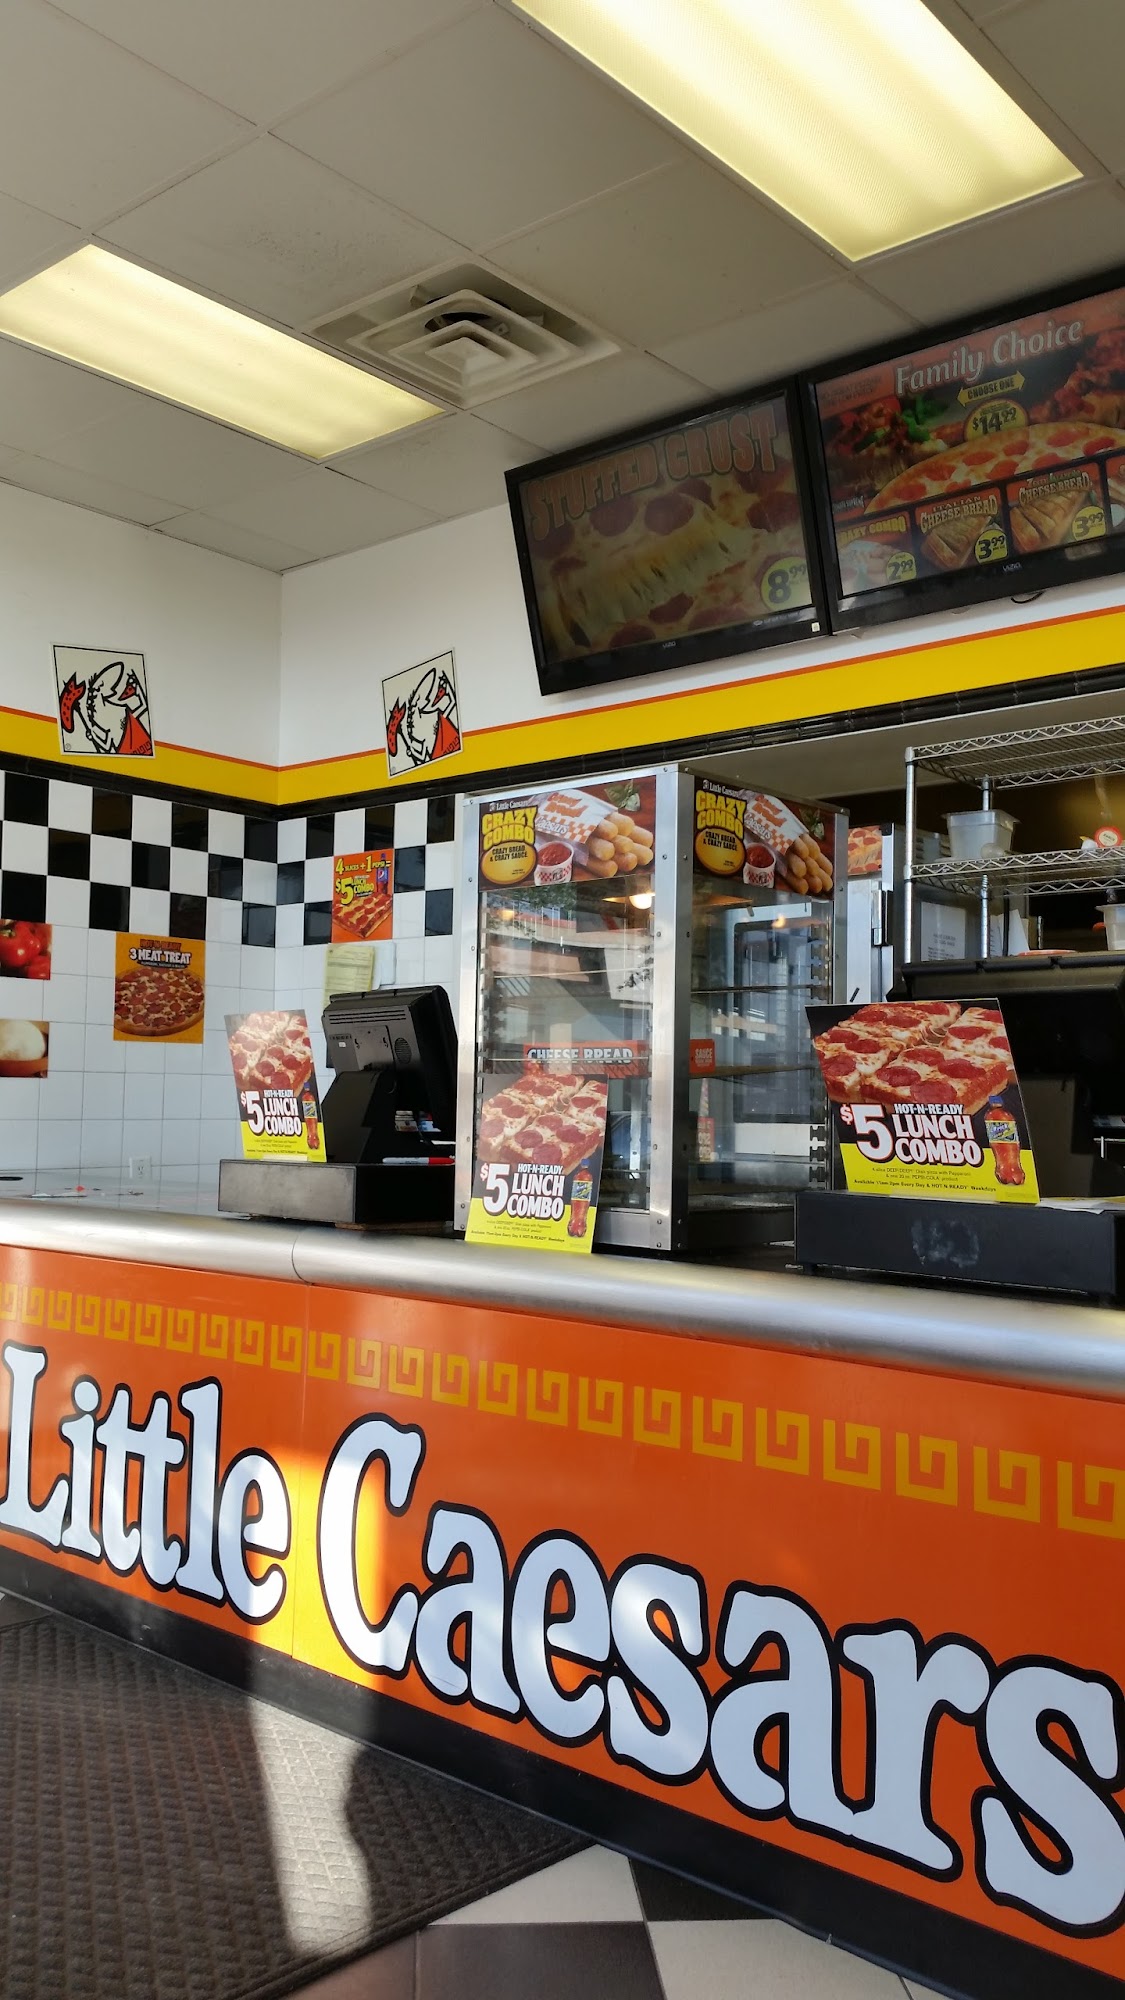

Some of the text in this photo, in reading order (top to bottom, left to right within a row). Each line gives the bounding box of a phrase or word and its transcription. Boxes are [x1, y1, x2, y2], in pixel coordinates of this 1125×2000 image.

[895, 346, 984, 397] Family
[992, 320, 1084, 365] Choice
[967, 377, 1015, 399] CHOOSE ONE
[527, 406, 779, 541] STUFFED CRUST
[932, 496, 981, 512] ITALIAN
[1019, 482, 1057, 507] CHEESE
[868, 515, 907, 534] COMBO
[920, 494, 998, 534] CHEESE BREAD
[695, 789, 747, 823] CRAZY
[481, 806, 538, 836] CRAZY
[534, 816, 570, 836] Caesars
[696, 809, 744, 841] COMBO
[483, 823, 536, 851] COMBO
[705, 829, 736, 845] CRAZY BREAD
[707, 838, 723, 849] CRAZY
[722, 840, 738, 852] SAUCE
[492, 845, 526, 856] CRAZY BREAD
[494, 853, 511, 862] CRAZY
[511, 851, 528, 860] SAUCE
[336, 858, 344, 875] 4
[366, 855, 372, 873] 1
[335, 876, 354, 906] $5
[129, 947, 137, 960] 3
[138, 949, 162, 962] MEAT
[163, 951, 192, 965] TREAT
[527, 1047, 634, 1064] CHEESE BREAD
[695, 1047, 713, 1061] SAUCE
[263, 1089, 294, 1098] HOT-N-READY
[240, 1090, 265, 1135] $5
[263, 1097, 299, 1116] LUNCH
[893, 1103, 964, 1115] HOT-N-READY
[264, 1116, 302, 1136] COMBO
[839, 1103, 894, 1161] $5
[892, 1114, 976, 1140] LUNCH
[895, 1138, 982, 1166] COMBO
[517, 1164, 564, 1175] HOT-N-READY
[480, 1162, 509, 1214] $5
[511, 1173, 566, 1197] LUNCH
[506, 1194, 565, 1220] COMBO
[0, 1342, 1125, 1938] Little Caesars
